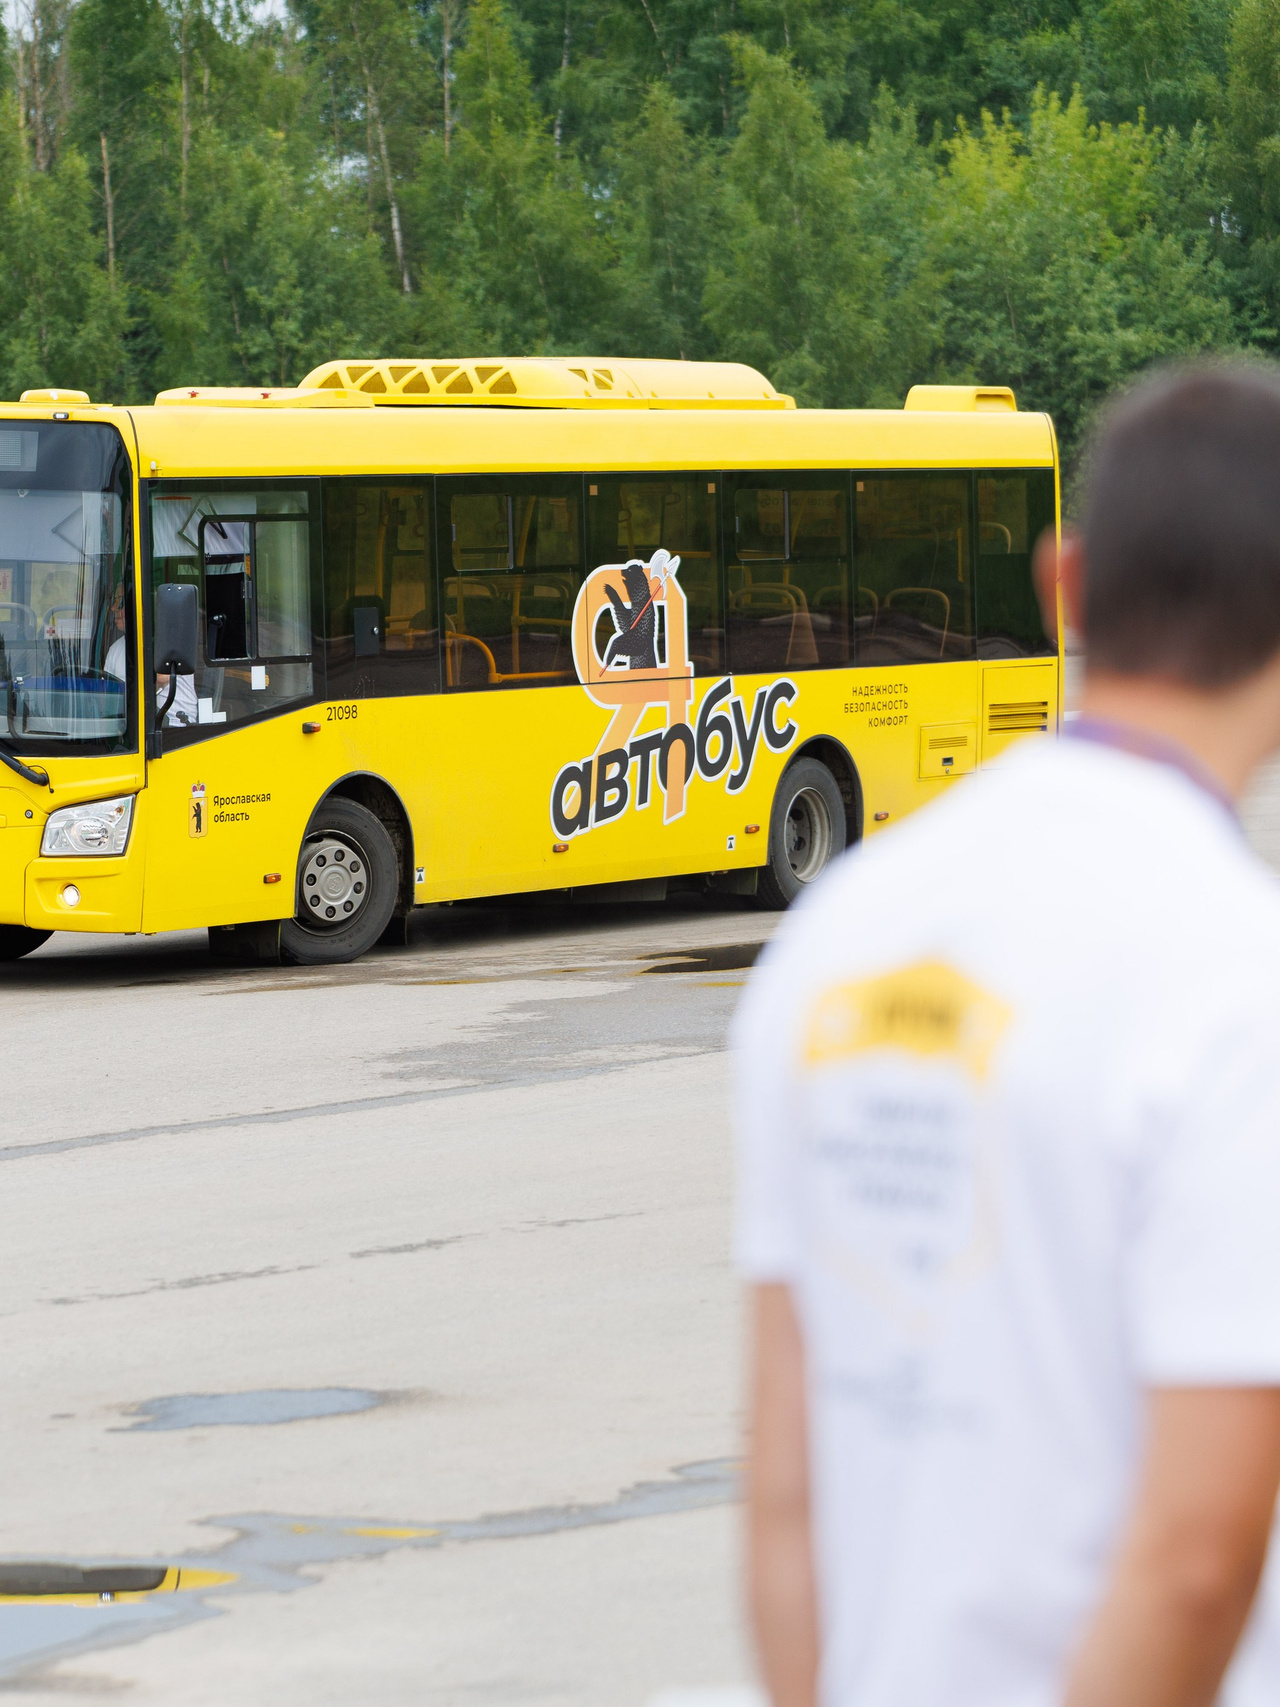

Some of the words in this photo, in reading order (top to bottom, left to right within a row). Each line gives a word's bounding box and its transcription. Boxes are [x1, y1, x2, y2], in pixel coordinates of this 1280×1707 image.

[852, 683, 909, 697] НАДЕЖНОСТЬ
[326, 704, 358, 721] 21098
[844, 700, 909, 713] БЕЗОПАСНОСТЬ
[868, 715, 909, 727] КОМФОРТ
[552, 678, 797, 837] автобус
[213, 793, 271, 808] Ярославская
[213, 811, 250, 823] область
